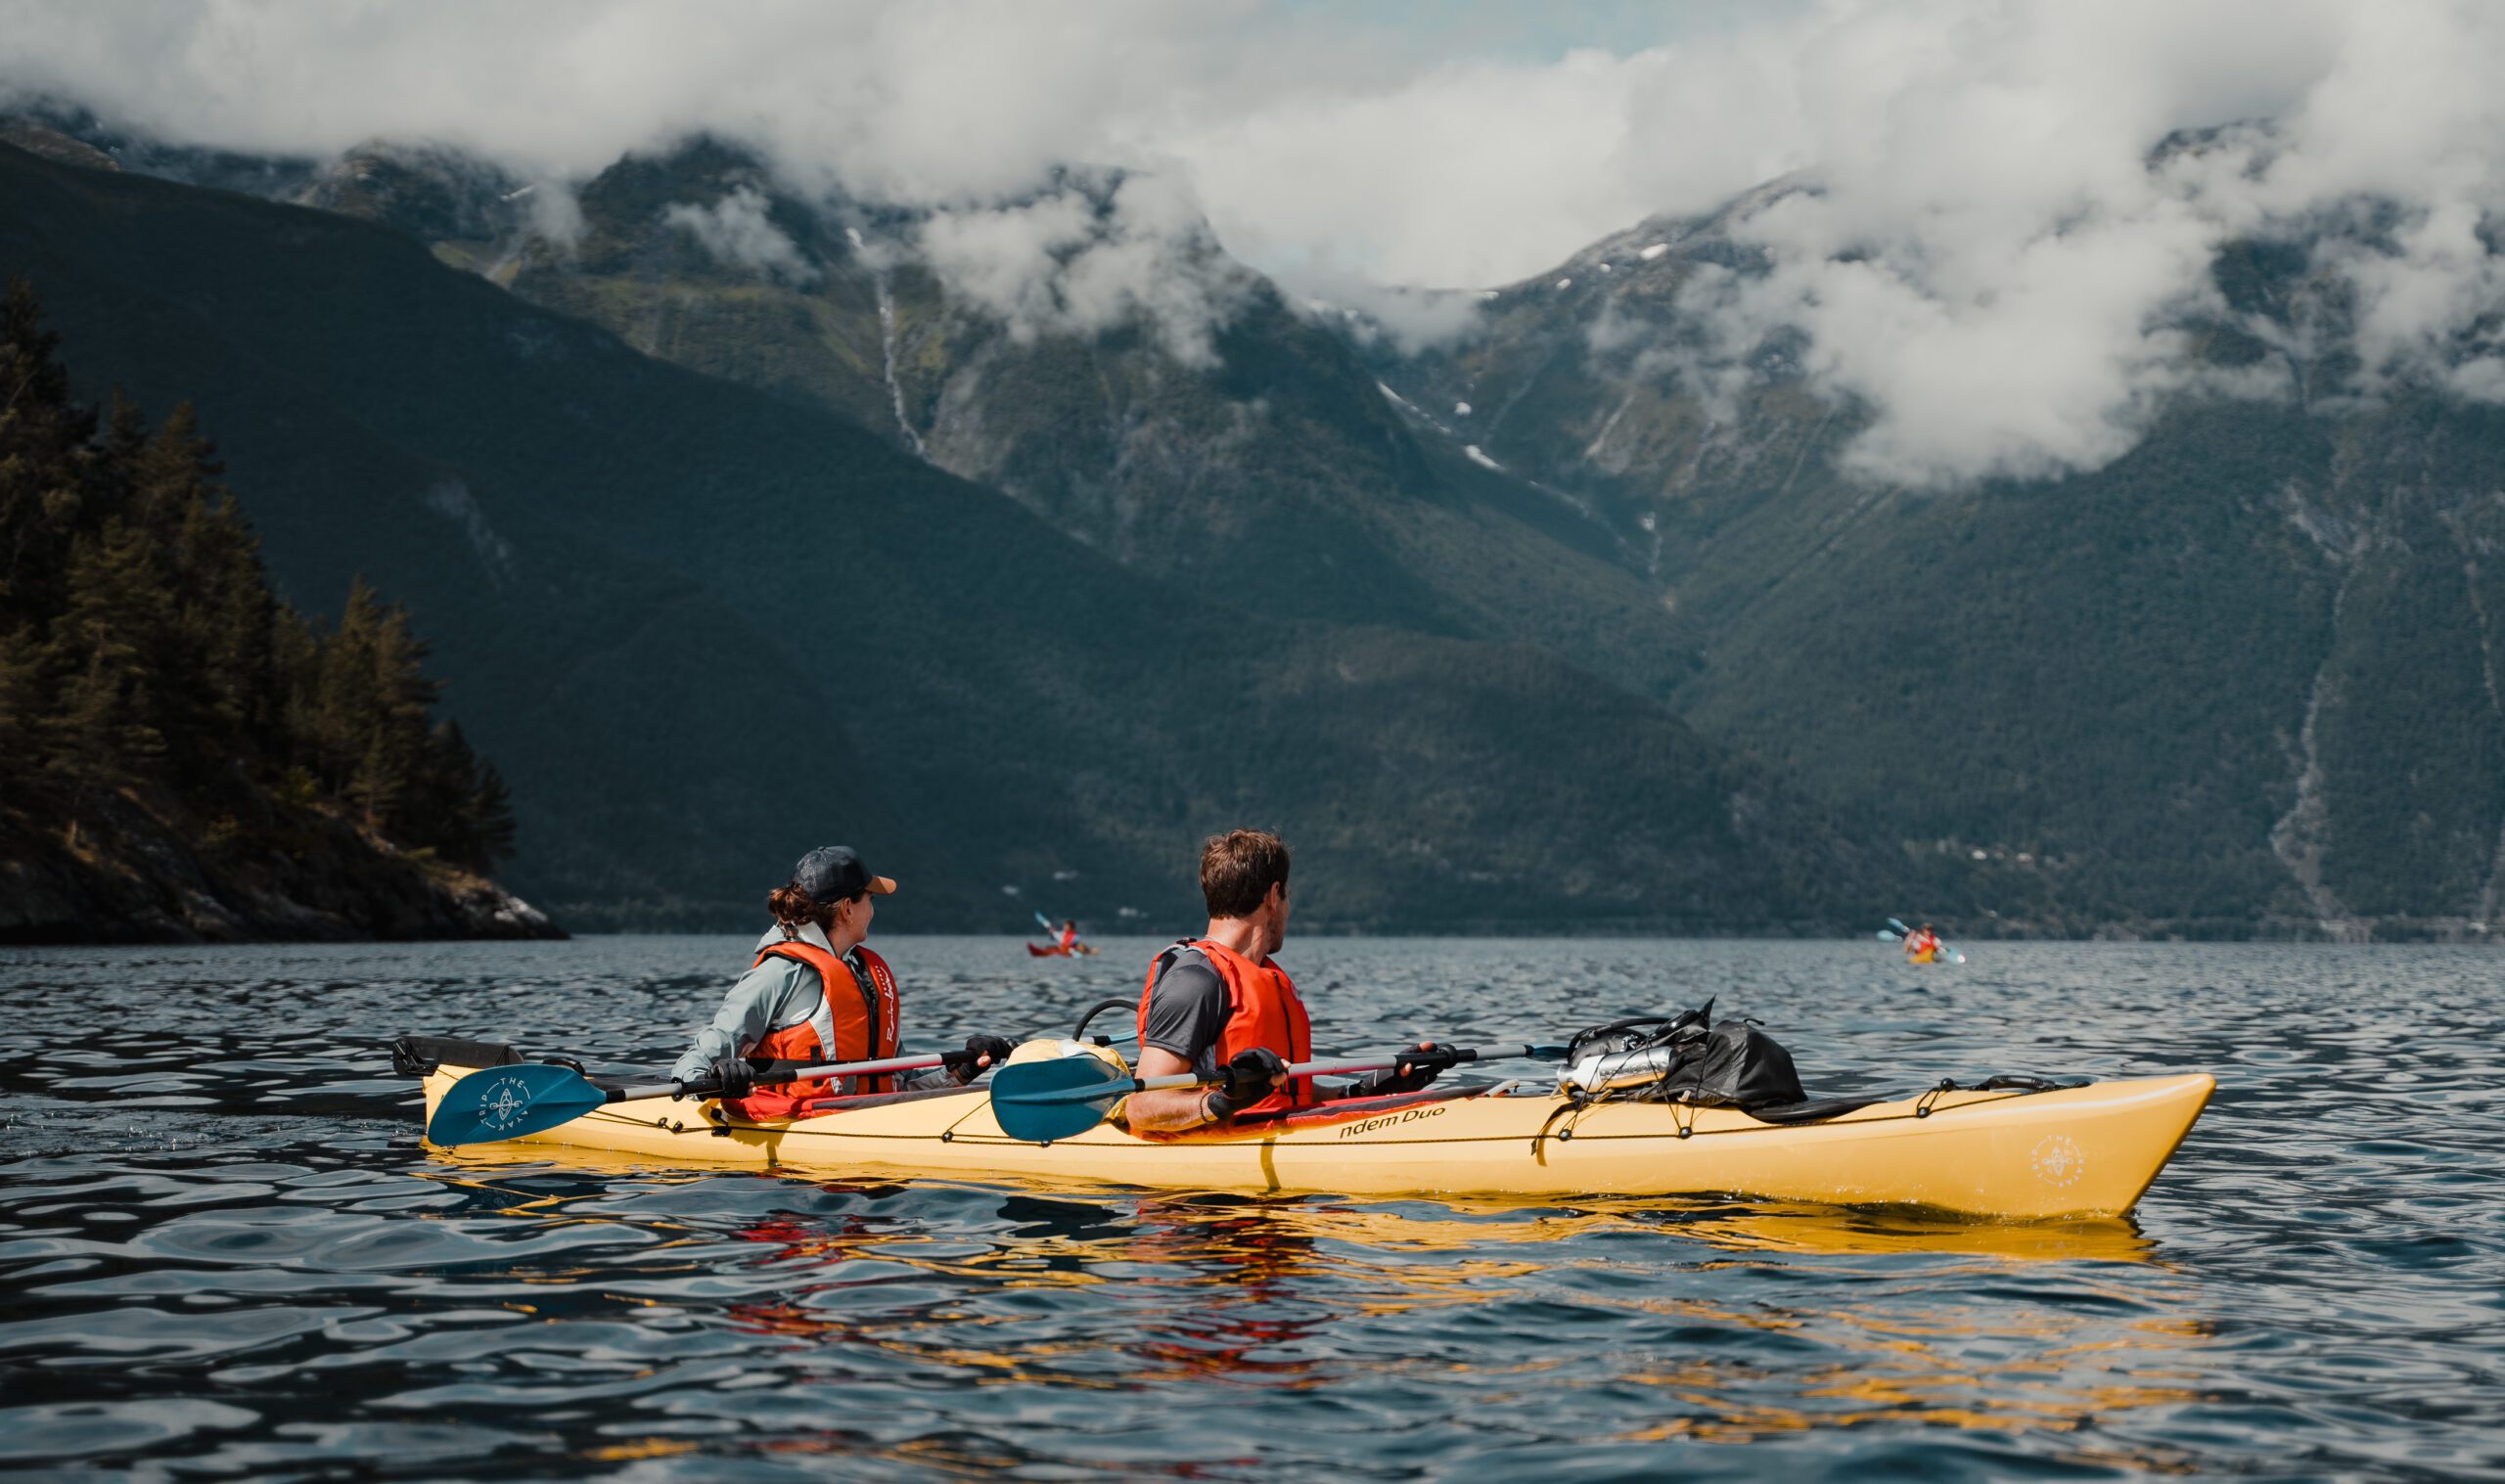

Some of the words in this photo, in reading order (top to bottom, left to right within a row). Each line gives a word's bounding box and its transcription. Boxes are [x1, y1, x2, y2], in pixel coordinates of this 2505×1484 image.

[500, 1077, 524, 1089] THE
[478, 1094, 488, 1125] TRIP
[498, 1107, 529, 1132] AYAK
[1340, 1115, 1398, 1139] ndem
[1401, 1107, 1446, 1123] Duo
